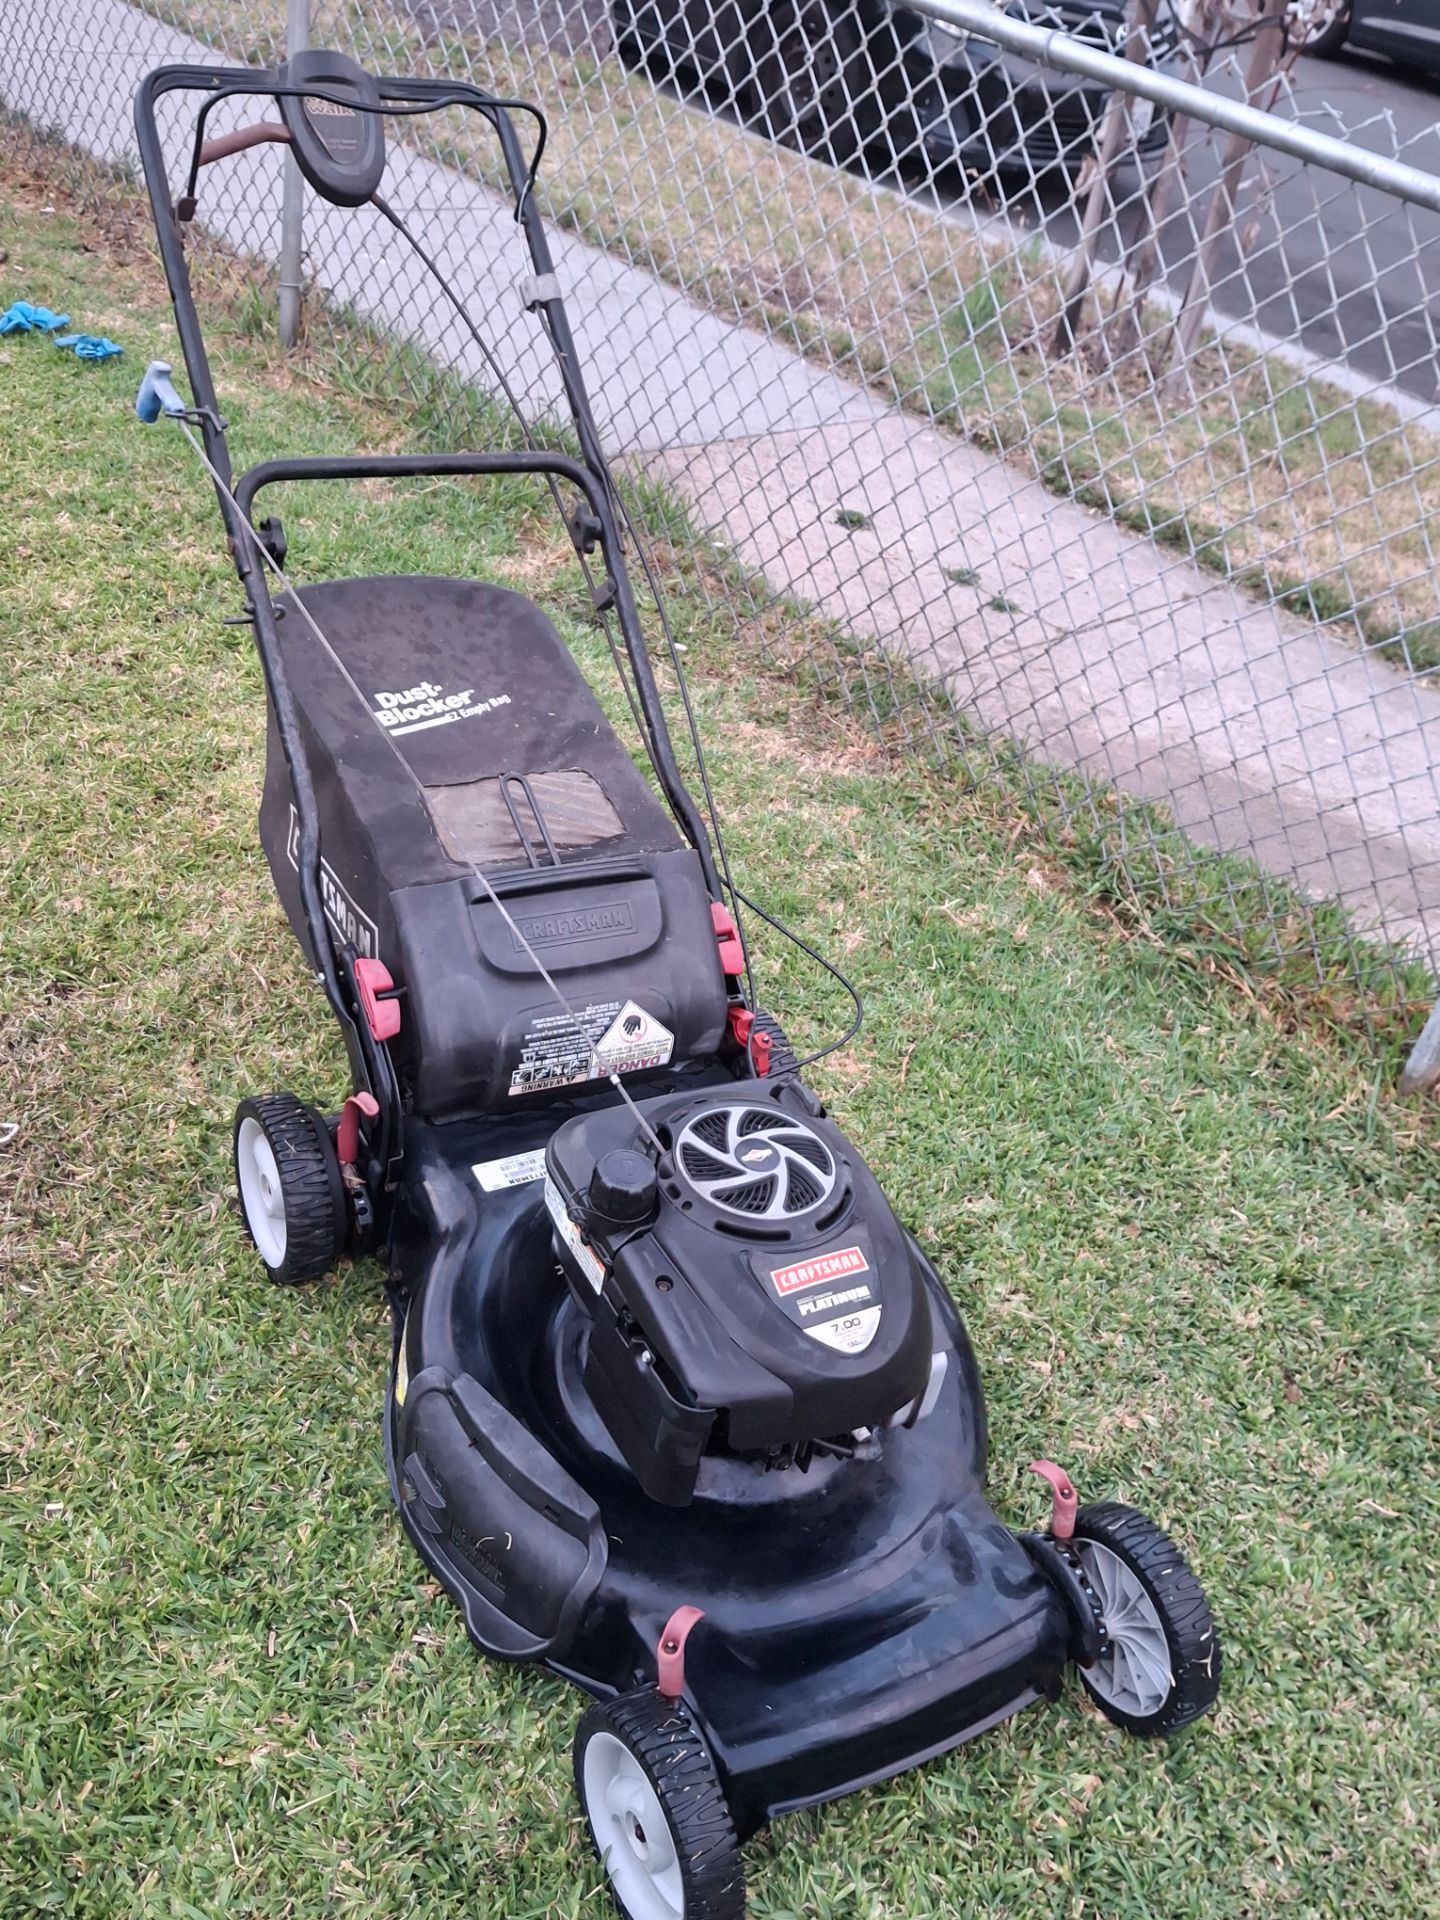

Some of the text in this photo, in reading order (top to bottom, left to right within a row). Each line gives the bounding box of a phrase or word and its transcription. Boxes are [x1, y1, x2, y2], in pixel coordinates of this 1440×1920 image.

[374, 681, 443, 709] Dust-
[374, 690, 473, 727] Blocker
[458, 702, 491, 718] Empty
[488, 694, 512, 708] Bag
[522, 910, 627, 941] CRAFTSMAN
[597, 1055, 662, 1077] DANGER
[521, 1077, 564, 1093] WARNING
[779, 1252, 861, 1288] CRAFTSMAN
[798, 1285, 871, 1316] PLATINUM
[830, 1317, 861, 1334] 7.00
